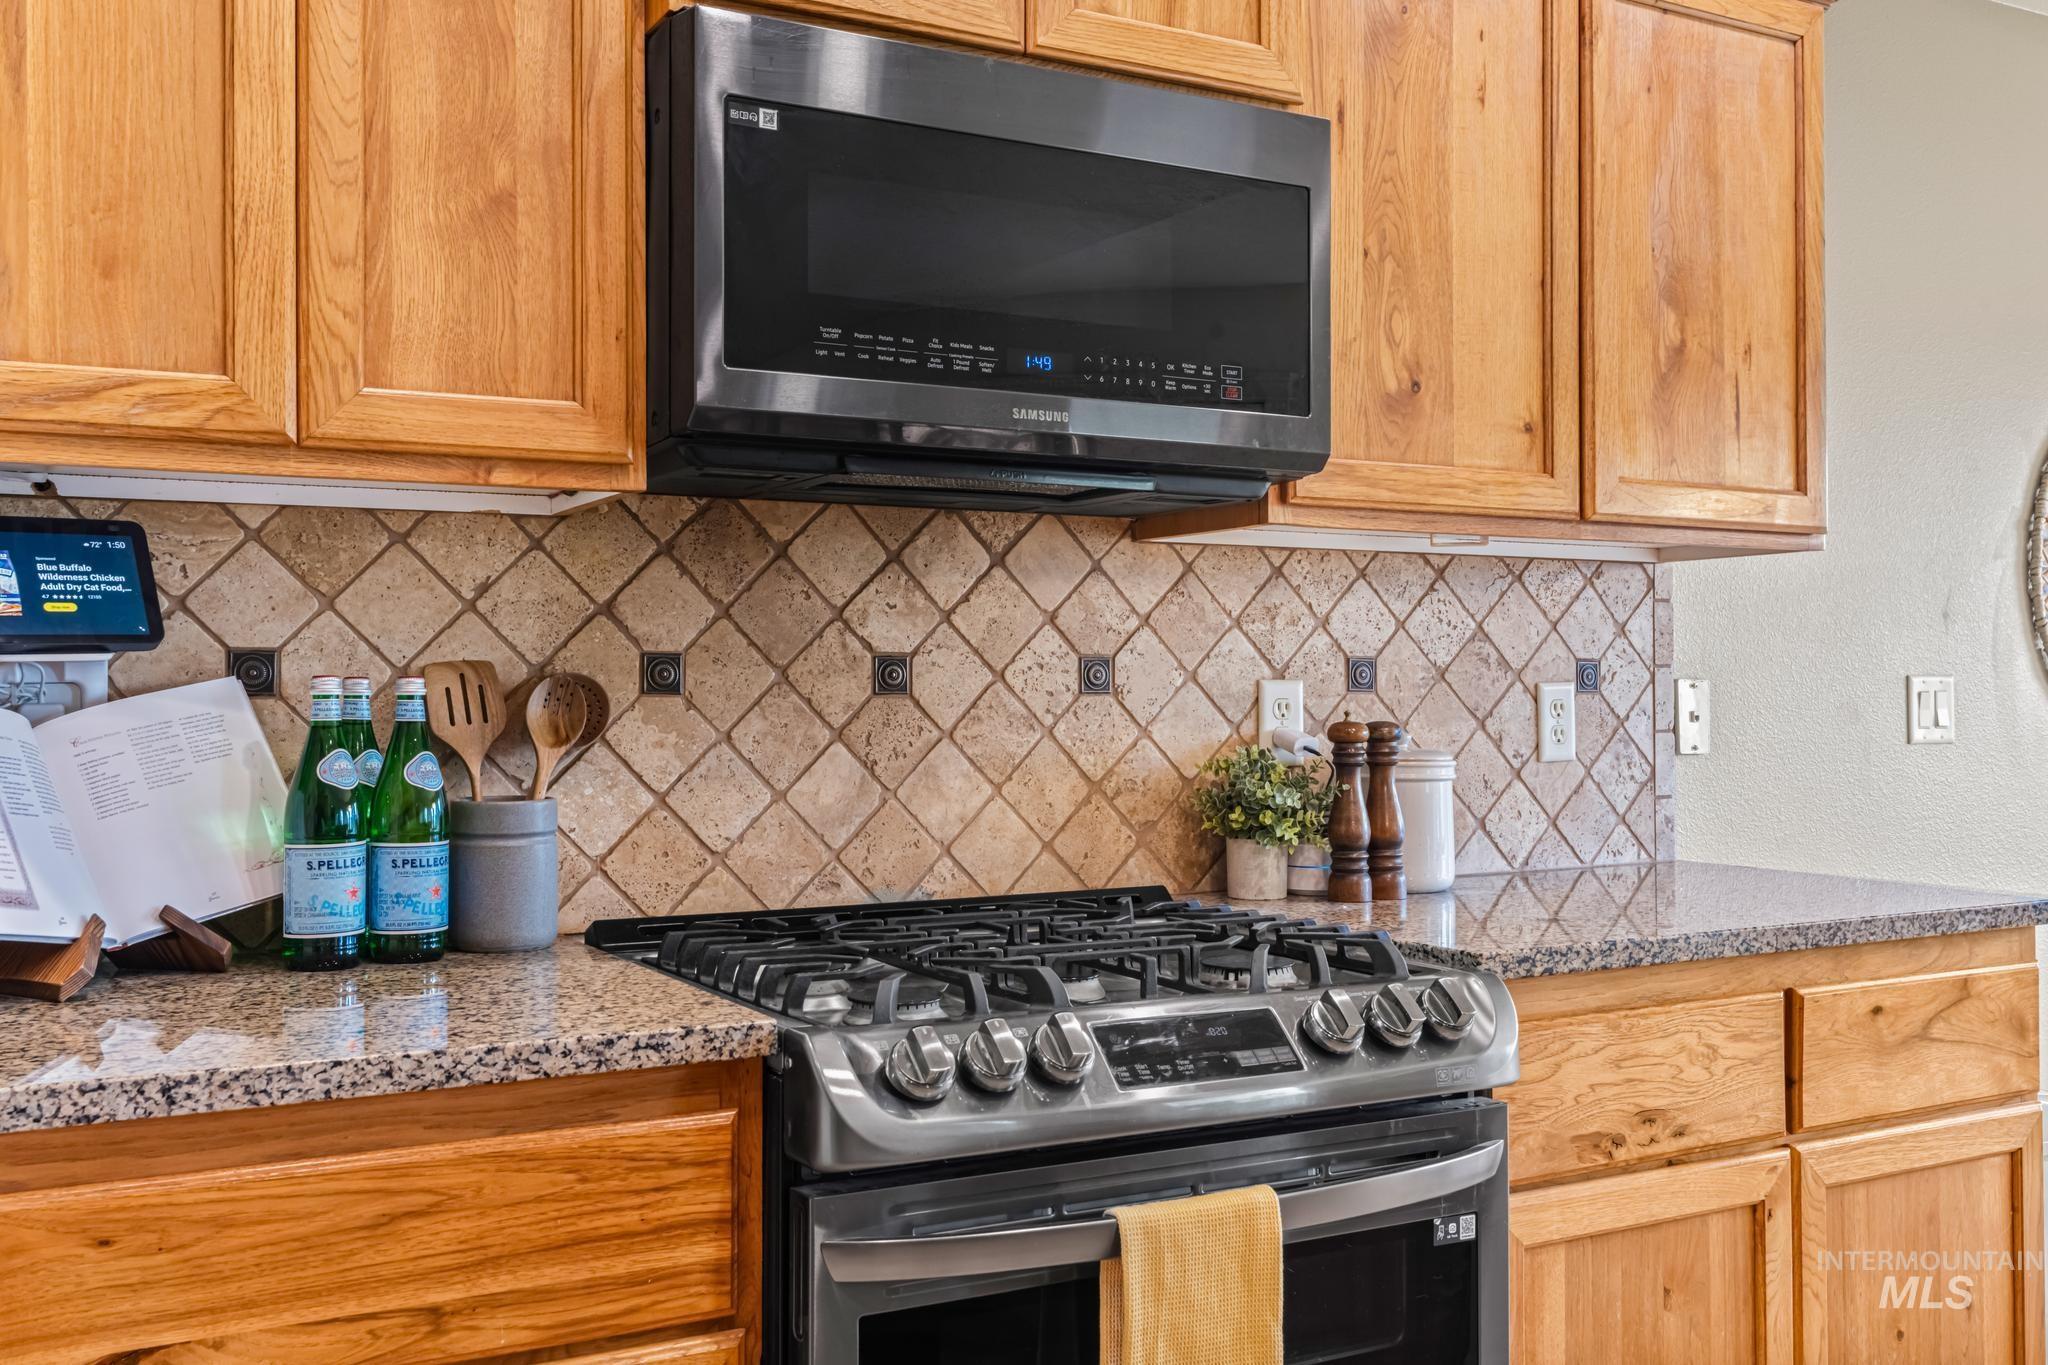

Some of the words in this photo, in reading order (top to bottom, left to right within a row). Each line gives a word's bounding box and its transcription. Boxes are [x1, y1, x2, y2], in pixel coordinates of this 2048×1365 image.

[1026, 356, 1053, 371] 1:49
[1012, 407, 1069, 423] SAMSUNG
[36, 563, 58, 571] Blue
[38, 573, 88, 581] Wilderness
[90, 574, 125, 582] Chicken
[66, 584, 82, 592] Dry
